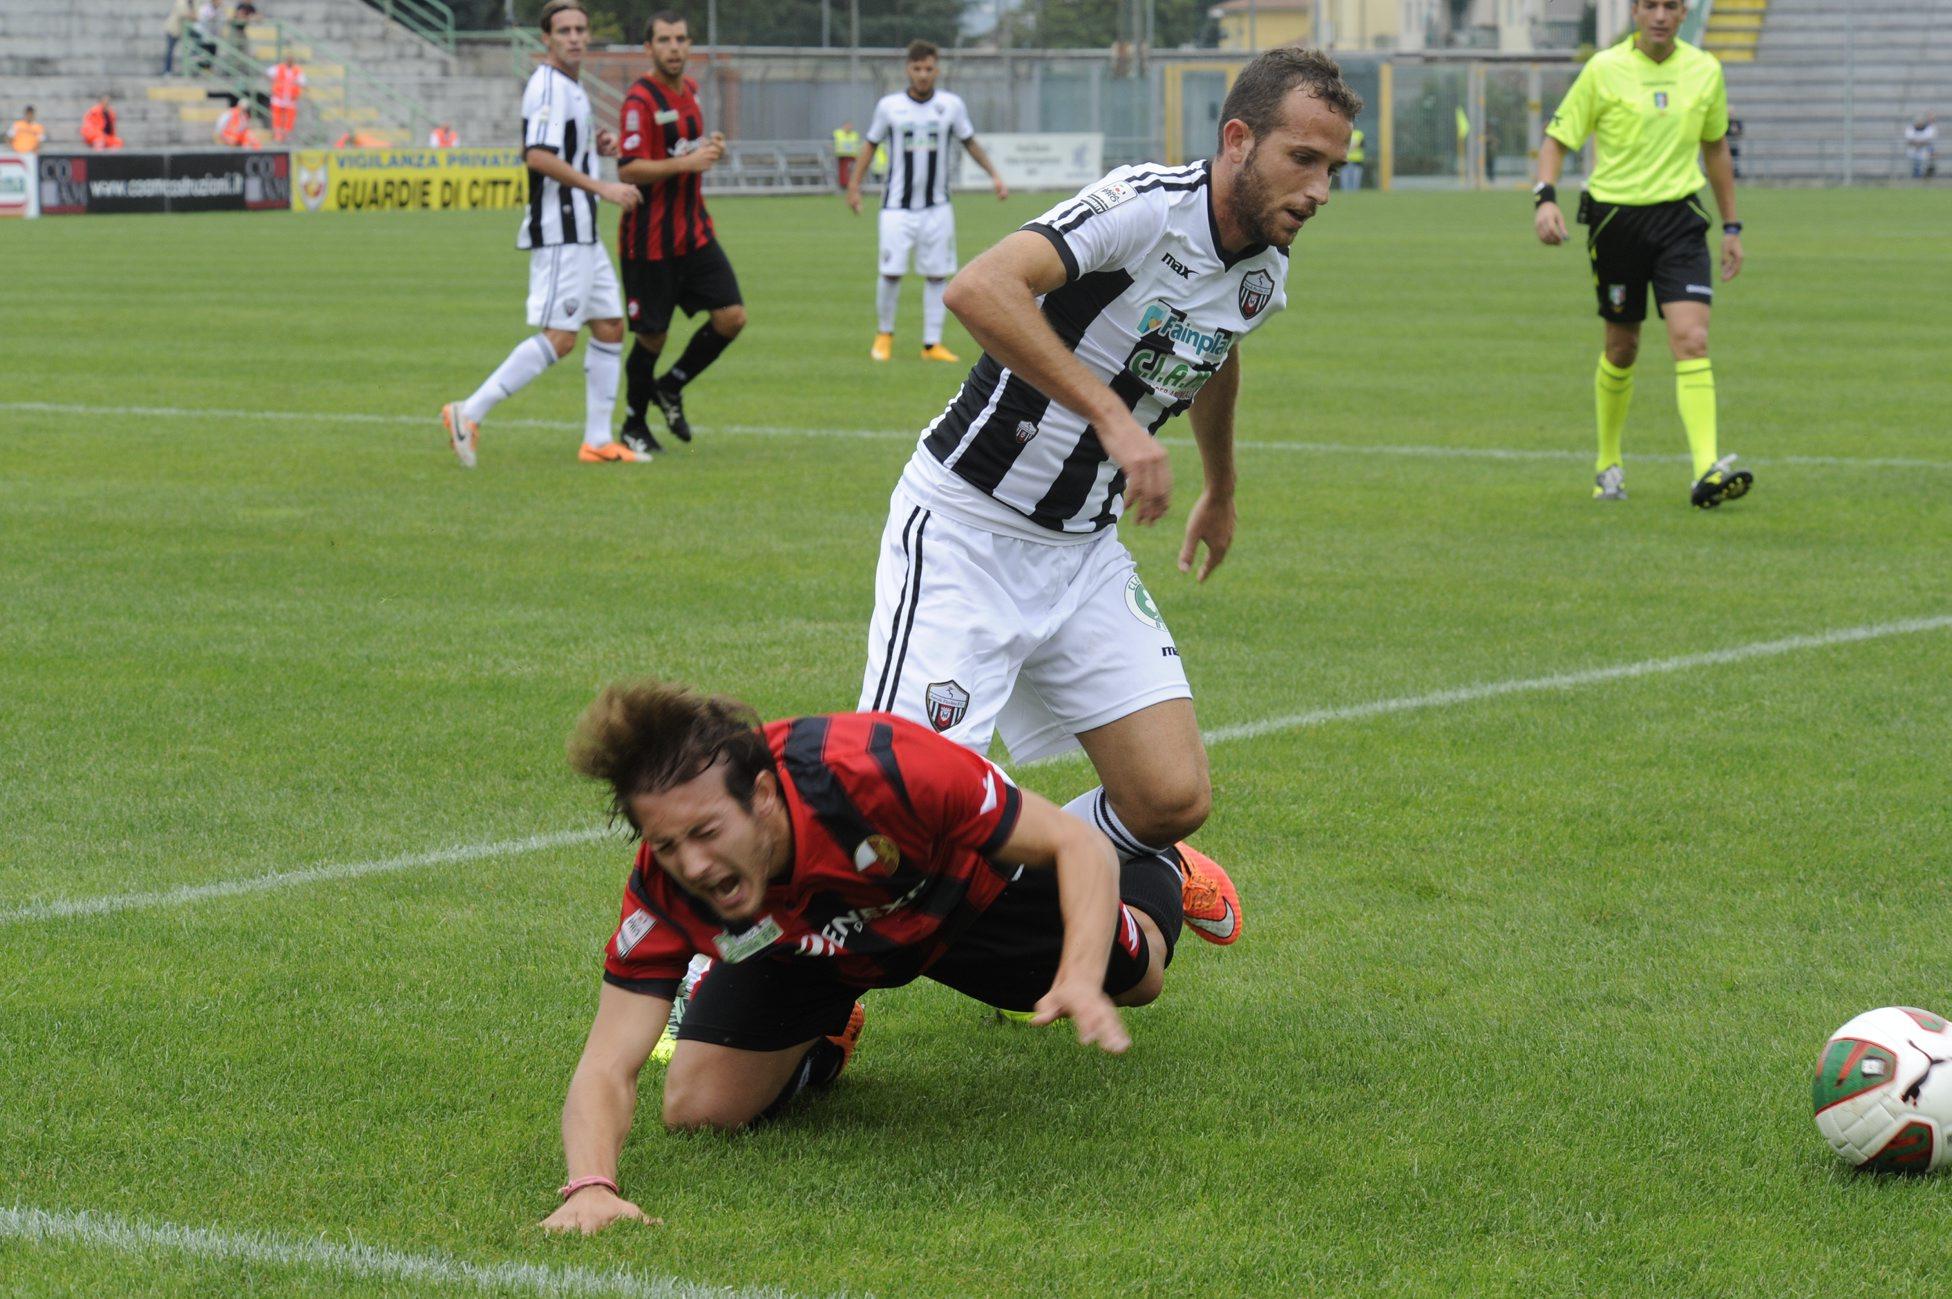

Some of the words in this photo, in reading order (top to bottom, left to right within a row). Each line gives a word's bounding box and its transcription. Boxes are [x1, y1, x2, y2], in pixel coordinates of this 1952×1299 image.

[337, 154, 436, 168] VIGILANZA
[337, 180, 431, 209] GUARDIE
[441, 180, 460, 208] DI
[1161, 252, 1199, 280] max
